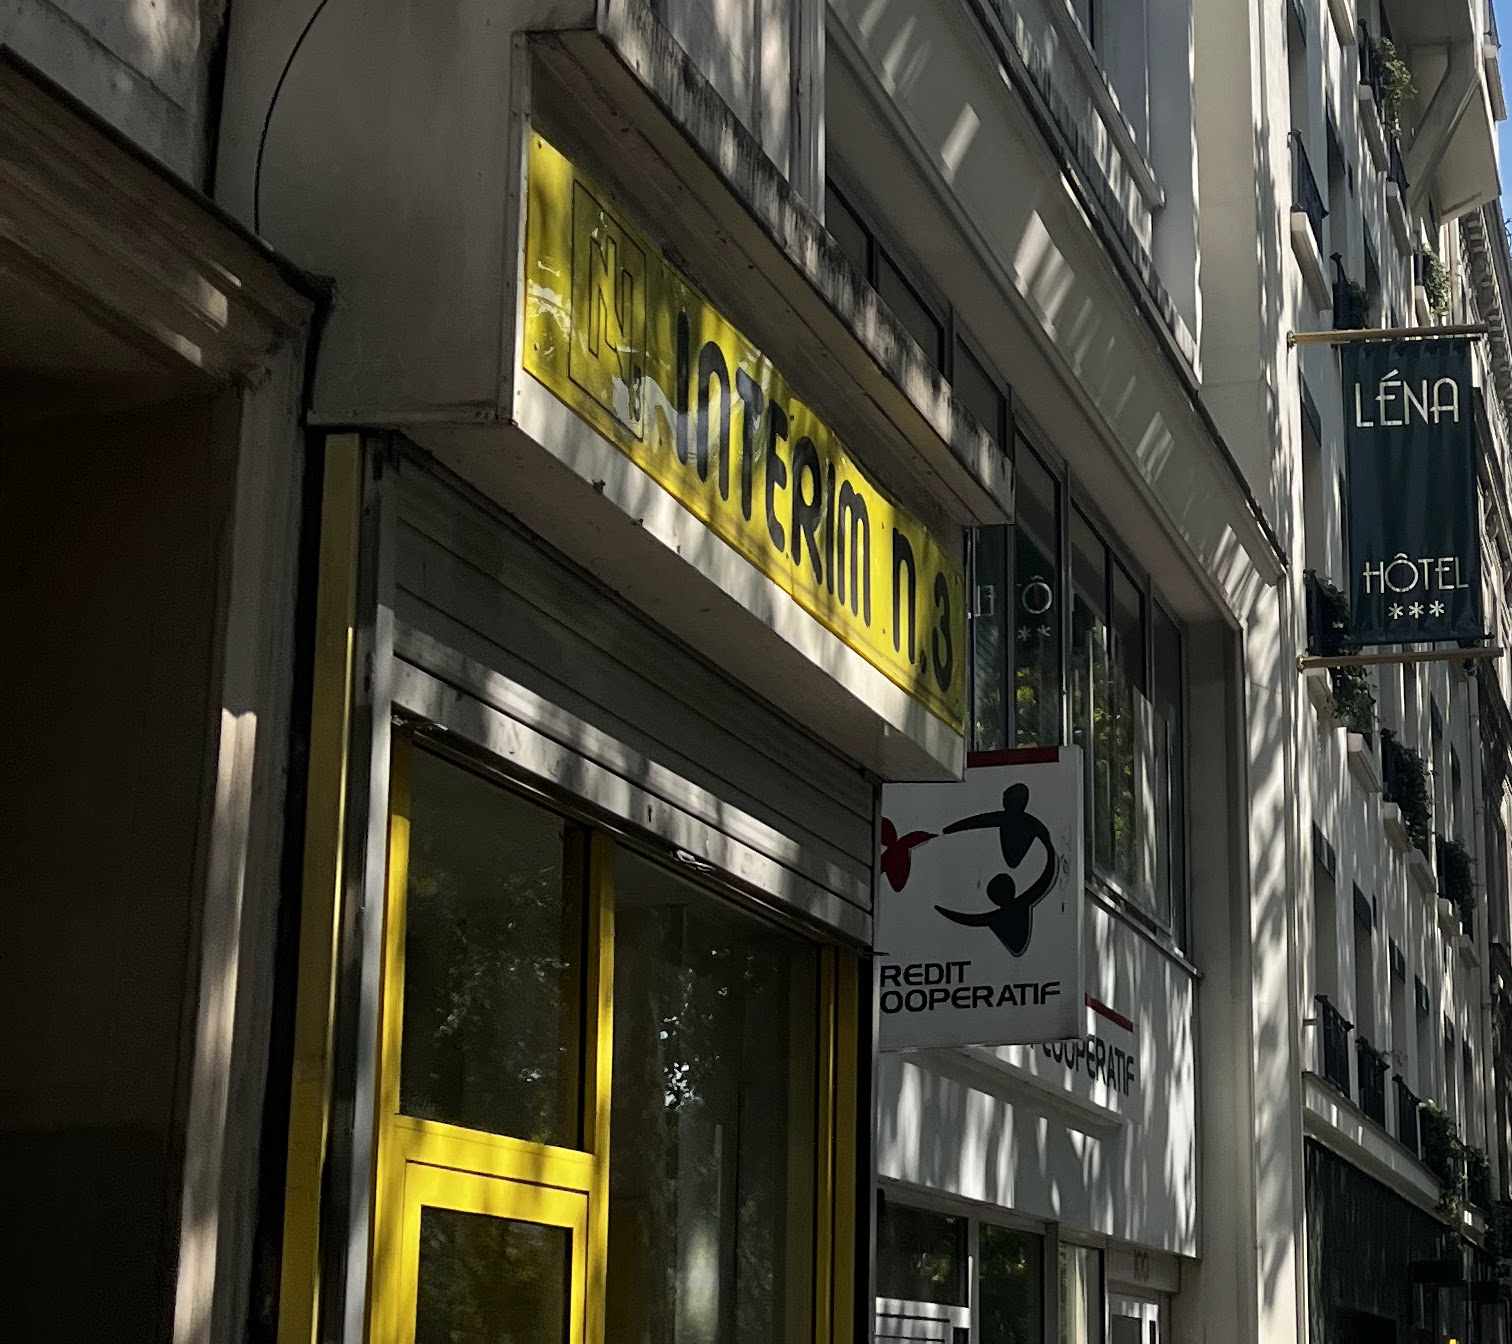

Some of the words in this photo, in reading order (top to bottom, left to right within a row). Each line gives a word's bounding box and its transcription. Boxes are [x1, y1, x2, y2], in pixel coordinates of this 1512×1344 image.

[1354, 368, 1460, 429] LÉNA
[1362, 552, 1470, 595] HÔTEL
[880, 960, 972, 988] REDIT
[879, 980, 1061, 1014] OOPERATIF
